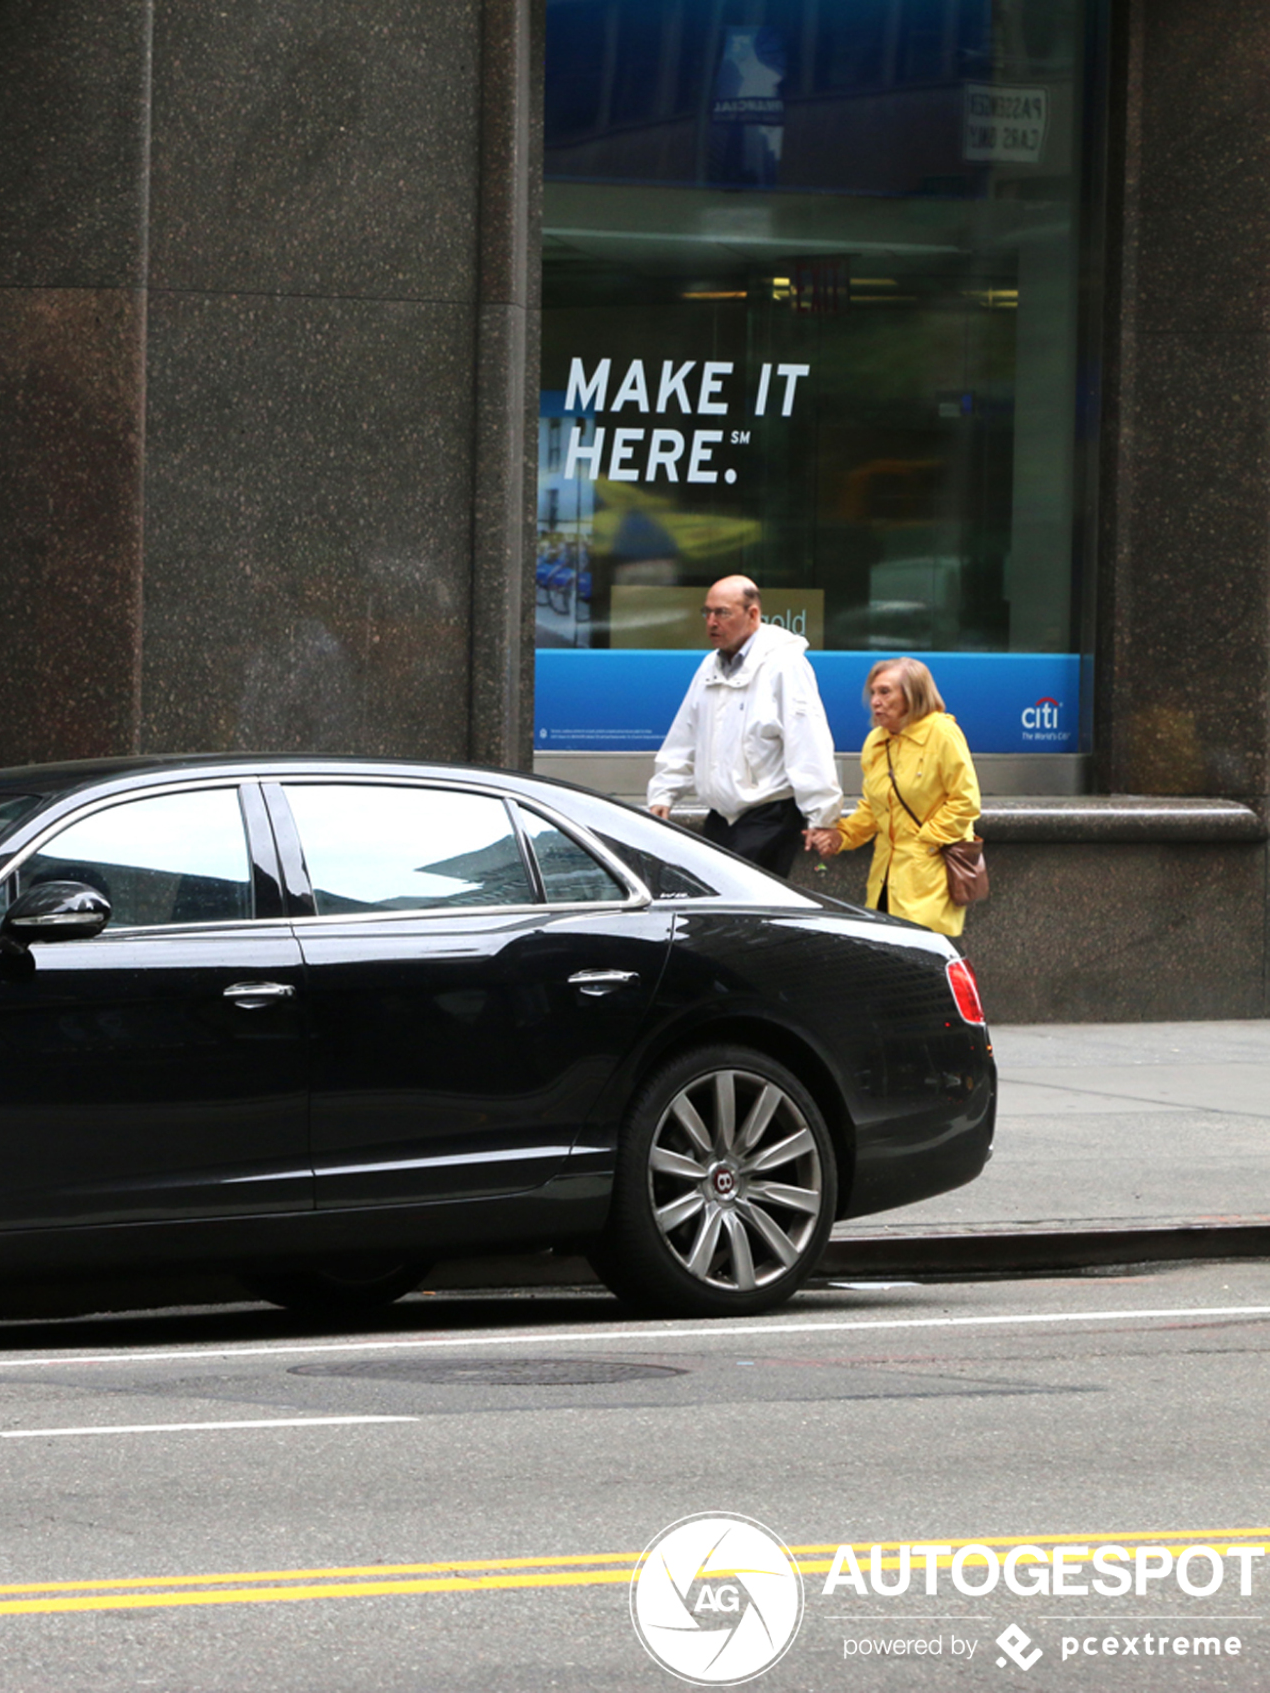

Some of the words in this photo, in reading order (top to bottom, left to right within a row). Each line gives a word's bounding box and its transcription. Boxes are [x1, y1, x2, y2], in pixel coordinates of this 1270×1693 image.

[564, 357, 734, 415] MAKE
[754, 363, 810, 417] IT
[564, 426, 737, 484] HERE.
[1021, 702, 1058, 729] citi
